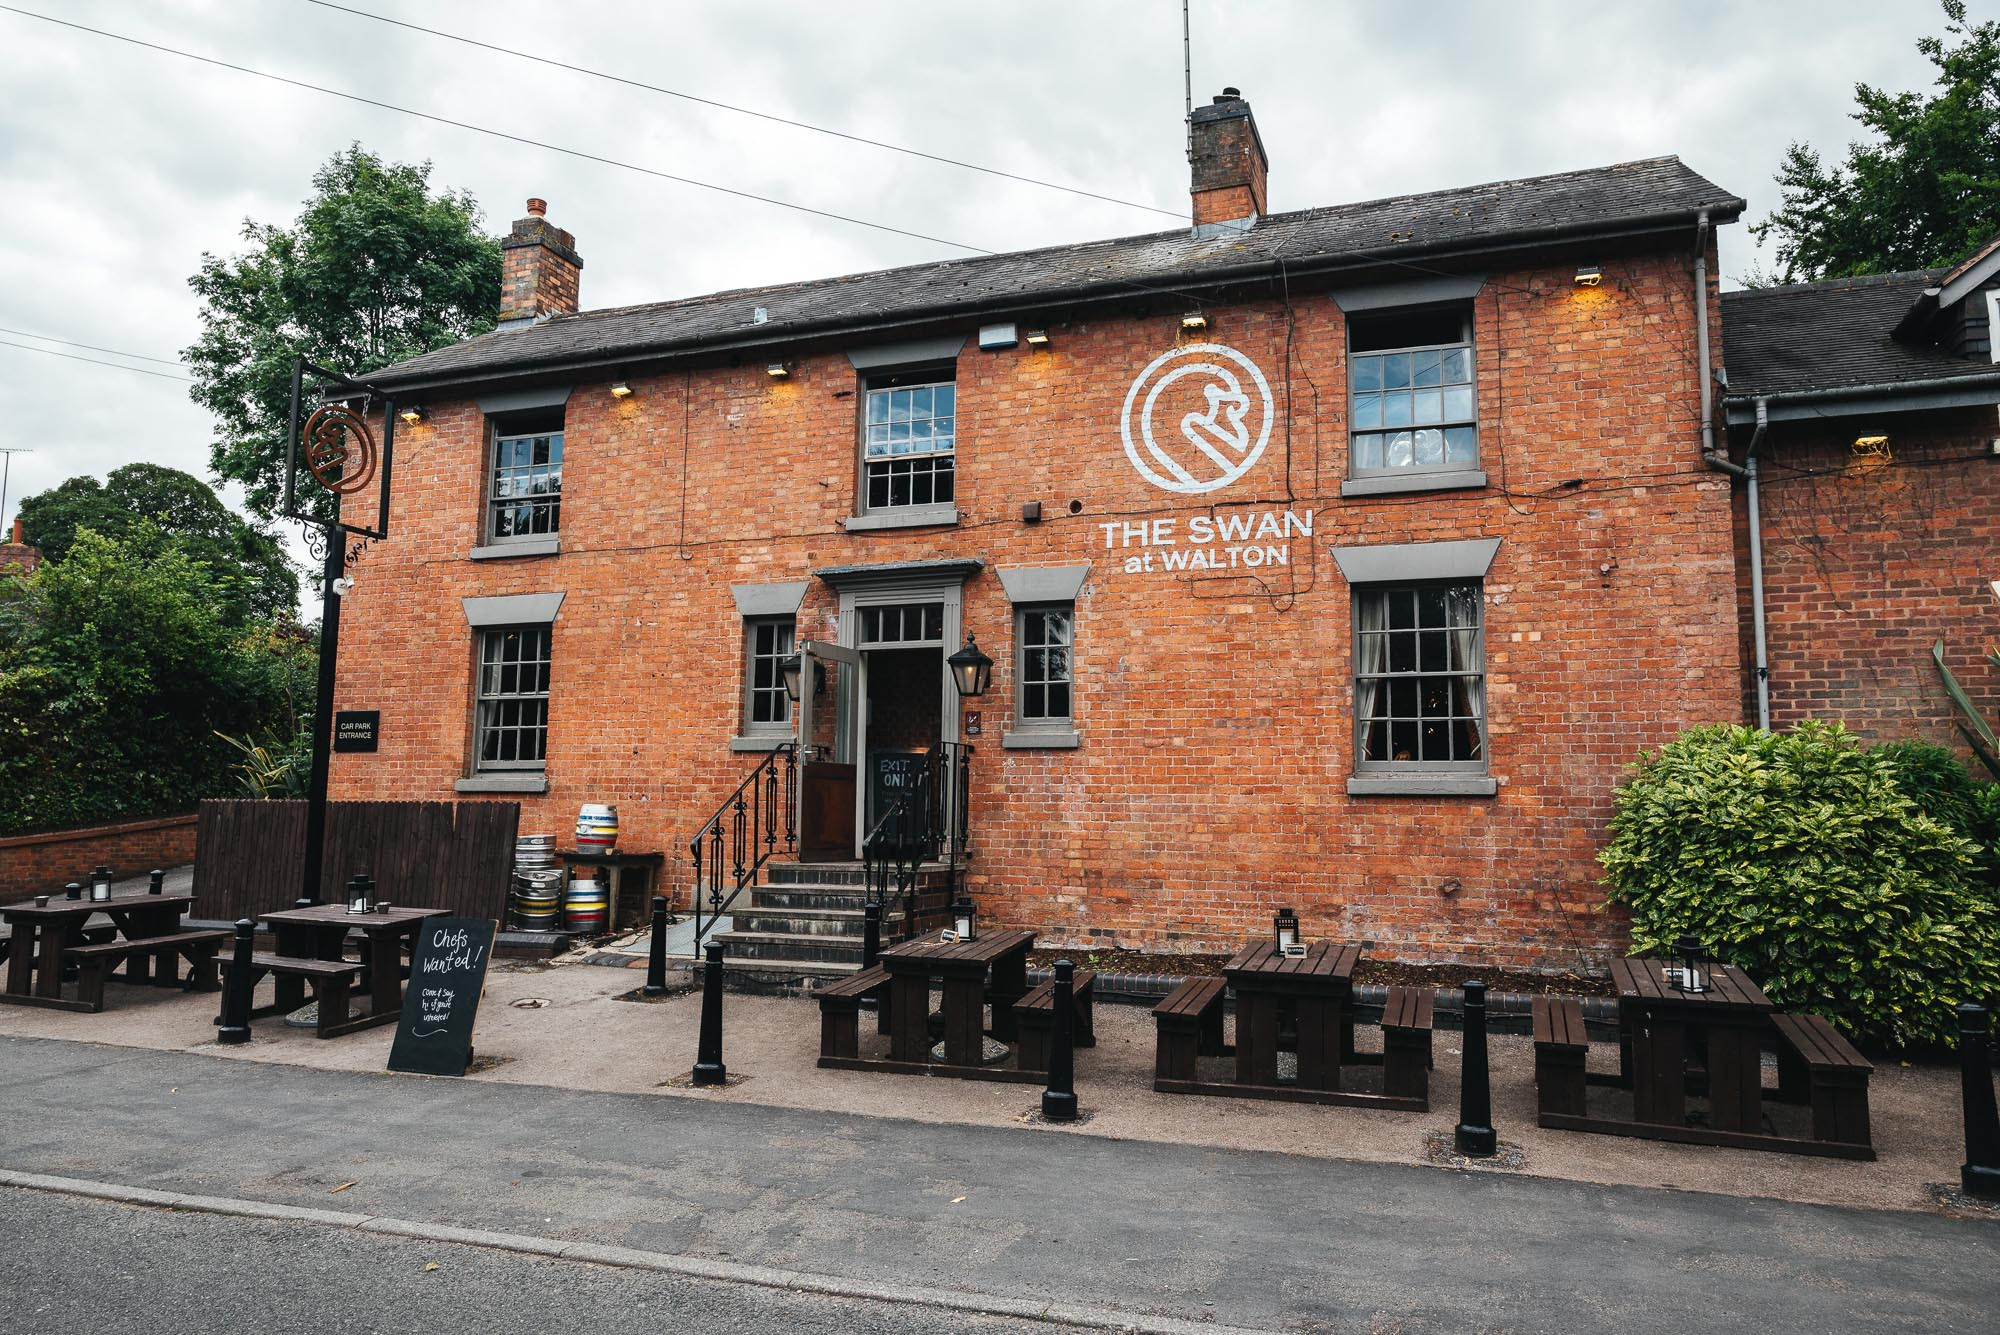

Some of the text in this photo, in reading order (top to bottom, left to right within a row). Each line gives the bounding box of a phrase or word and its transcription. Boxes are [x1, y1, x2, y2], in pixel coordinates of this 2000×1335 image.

[1099, 510, 1313, 549] THE SWAN
[1124, 544, 1288, 574] at WALTON
[341, 722, 371, 730] CAR PARK
[880, 760, 910, 772] EXIT
[433, 928, 468, 954] Chefs
